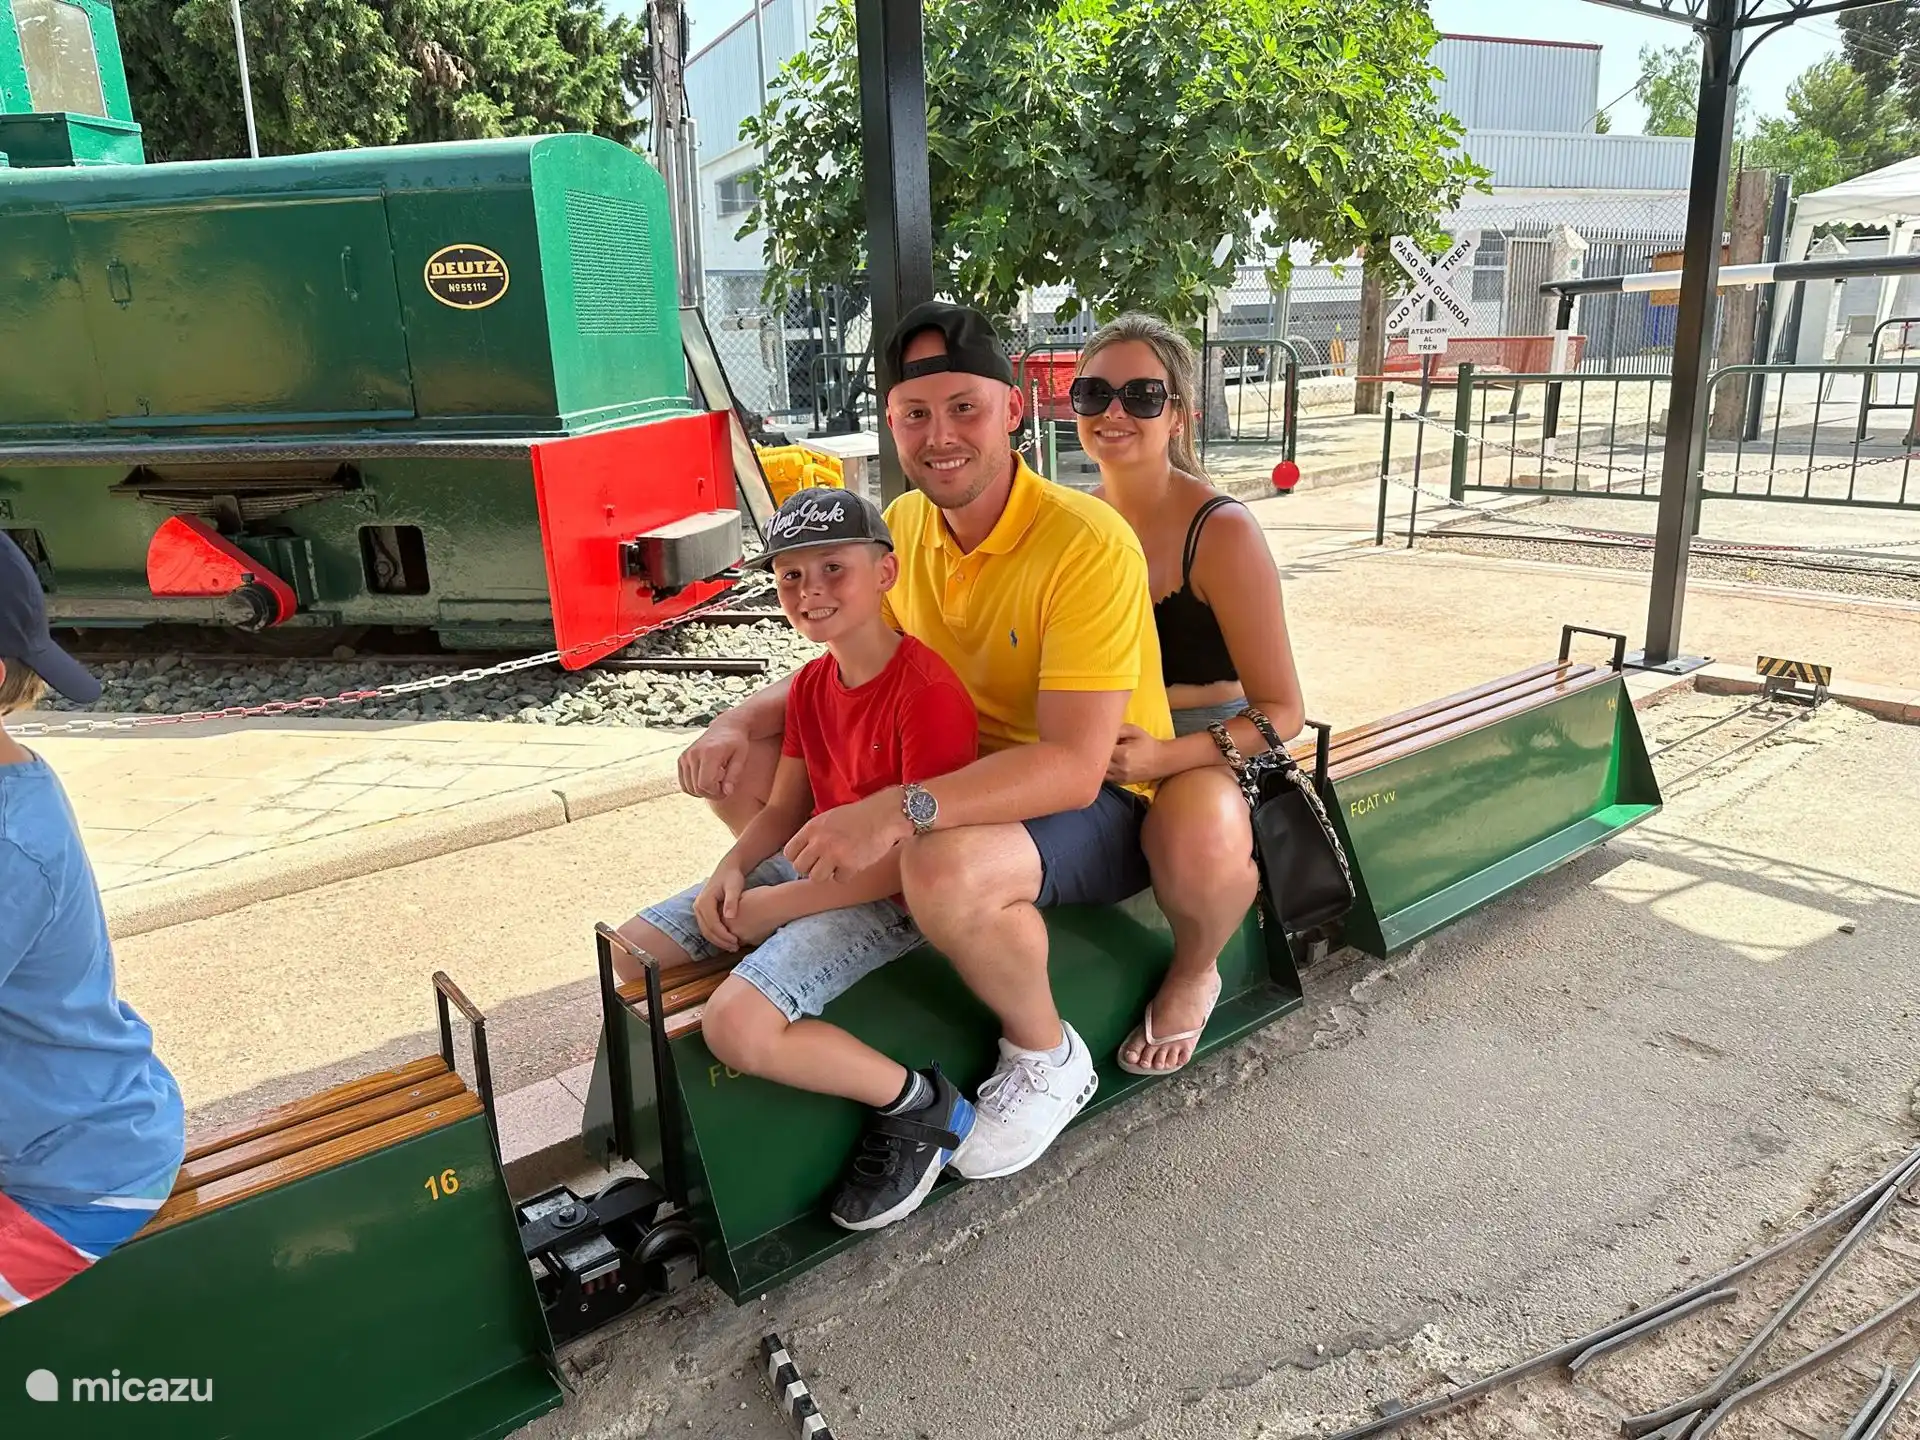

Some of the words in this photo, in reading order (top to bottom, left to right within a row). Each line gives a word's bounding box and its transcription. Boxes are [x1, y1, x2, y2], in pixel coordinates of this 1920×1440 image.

[431, 261, 500, 275] DEUTZ
[1388, 306, 1410, 329] OJO
[1411, 292, 1426, 308] AL
[1440, 239, 1472, 272] TREN
[1394, 240, 1418, 268] PASO
[1416, 266, 1435, 287] SIN
[1433, 285, 1470, 327] GUARDA
[765, 508, 800, 541] New
[783, 499, 845, 538] York
[1350, 793, 1380, 818] FCAT
[424, 1168, 459, 1200] 16
